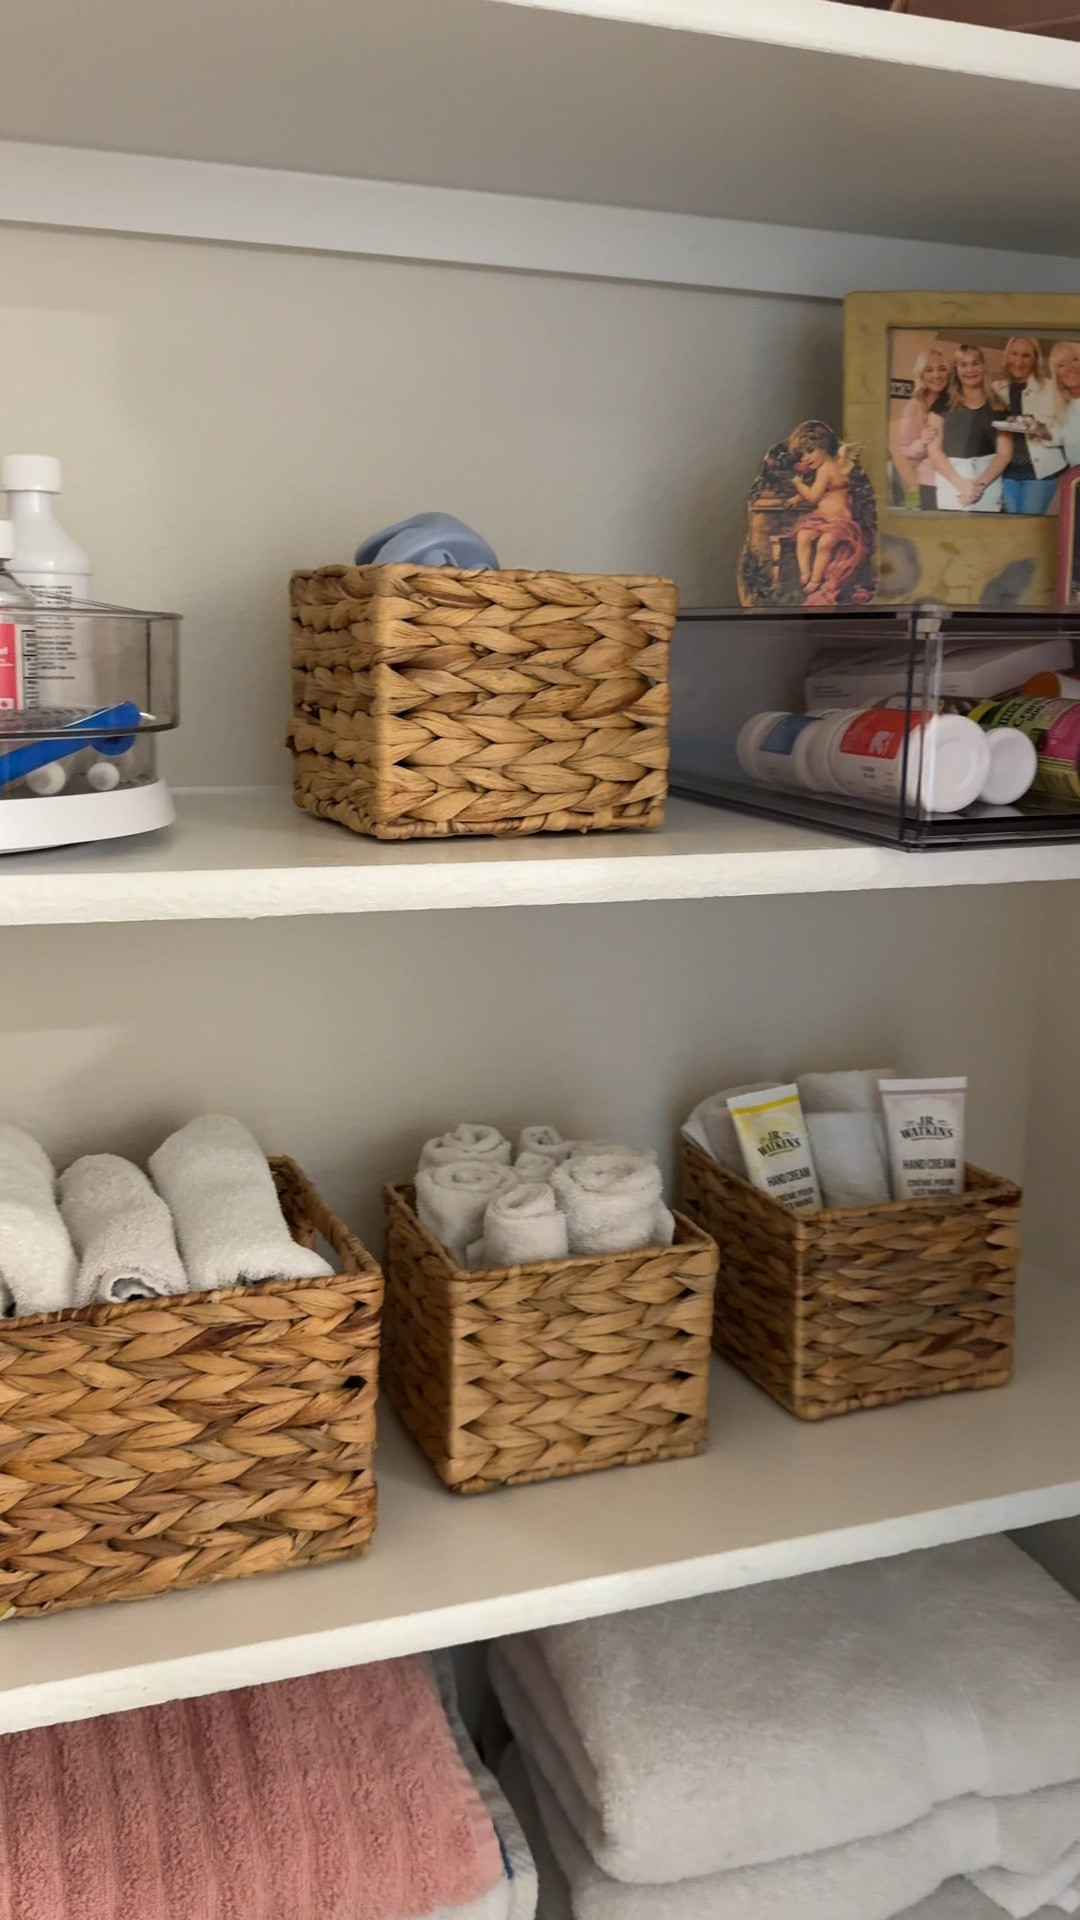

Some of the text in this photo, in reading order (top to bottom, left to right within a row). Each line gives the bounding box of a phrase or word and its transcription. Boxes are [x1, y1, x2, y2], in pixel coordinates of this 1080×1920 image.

[916, 1115, 935, 1127] JR
[766, 1130, 782, 1142] JR
[900, 1126, 955, 1139] WATKINS
[757, 1138, 802, 1156] WATKINS
[902, 1158, 956, 1170] HAND CREAM
[766, 1166, 811, 1187] HAND CREAM
